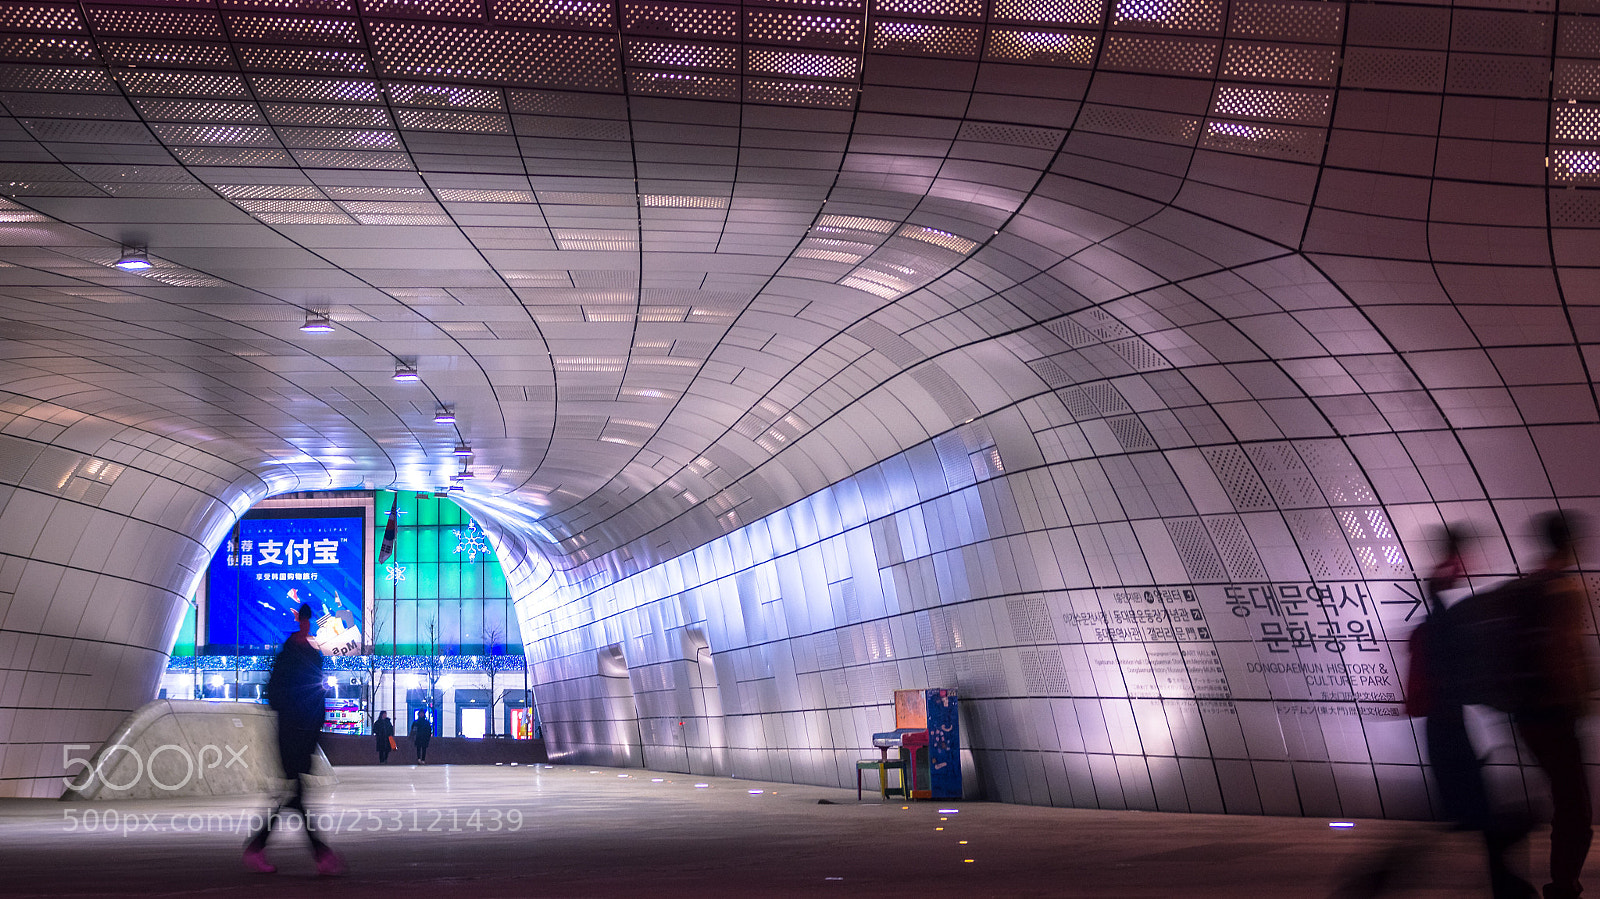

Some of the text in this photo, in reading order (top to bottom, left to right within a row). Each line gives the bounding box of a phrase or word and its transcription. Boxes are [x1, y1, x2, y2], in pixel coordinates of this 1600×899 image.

[258, 538, 339, 565] 支付宝
[1224, 583, 1368, 618] 동대문역사
[1261, 619, 1380, 653] 문화공원
[332, 639, 358, 656] apM
[1247, 662, 1389, 674] DONGDAEMUN HISTORY &
[1306, 675, 1391, 686] CULTURE PARK
